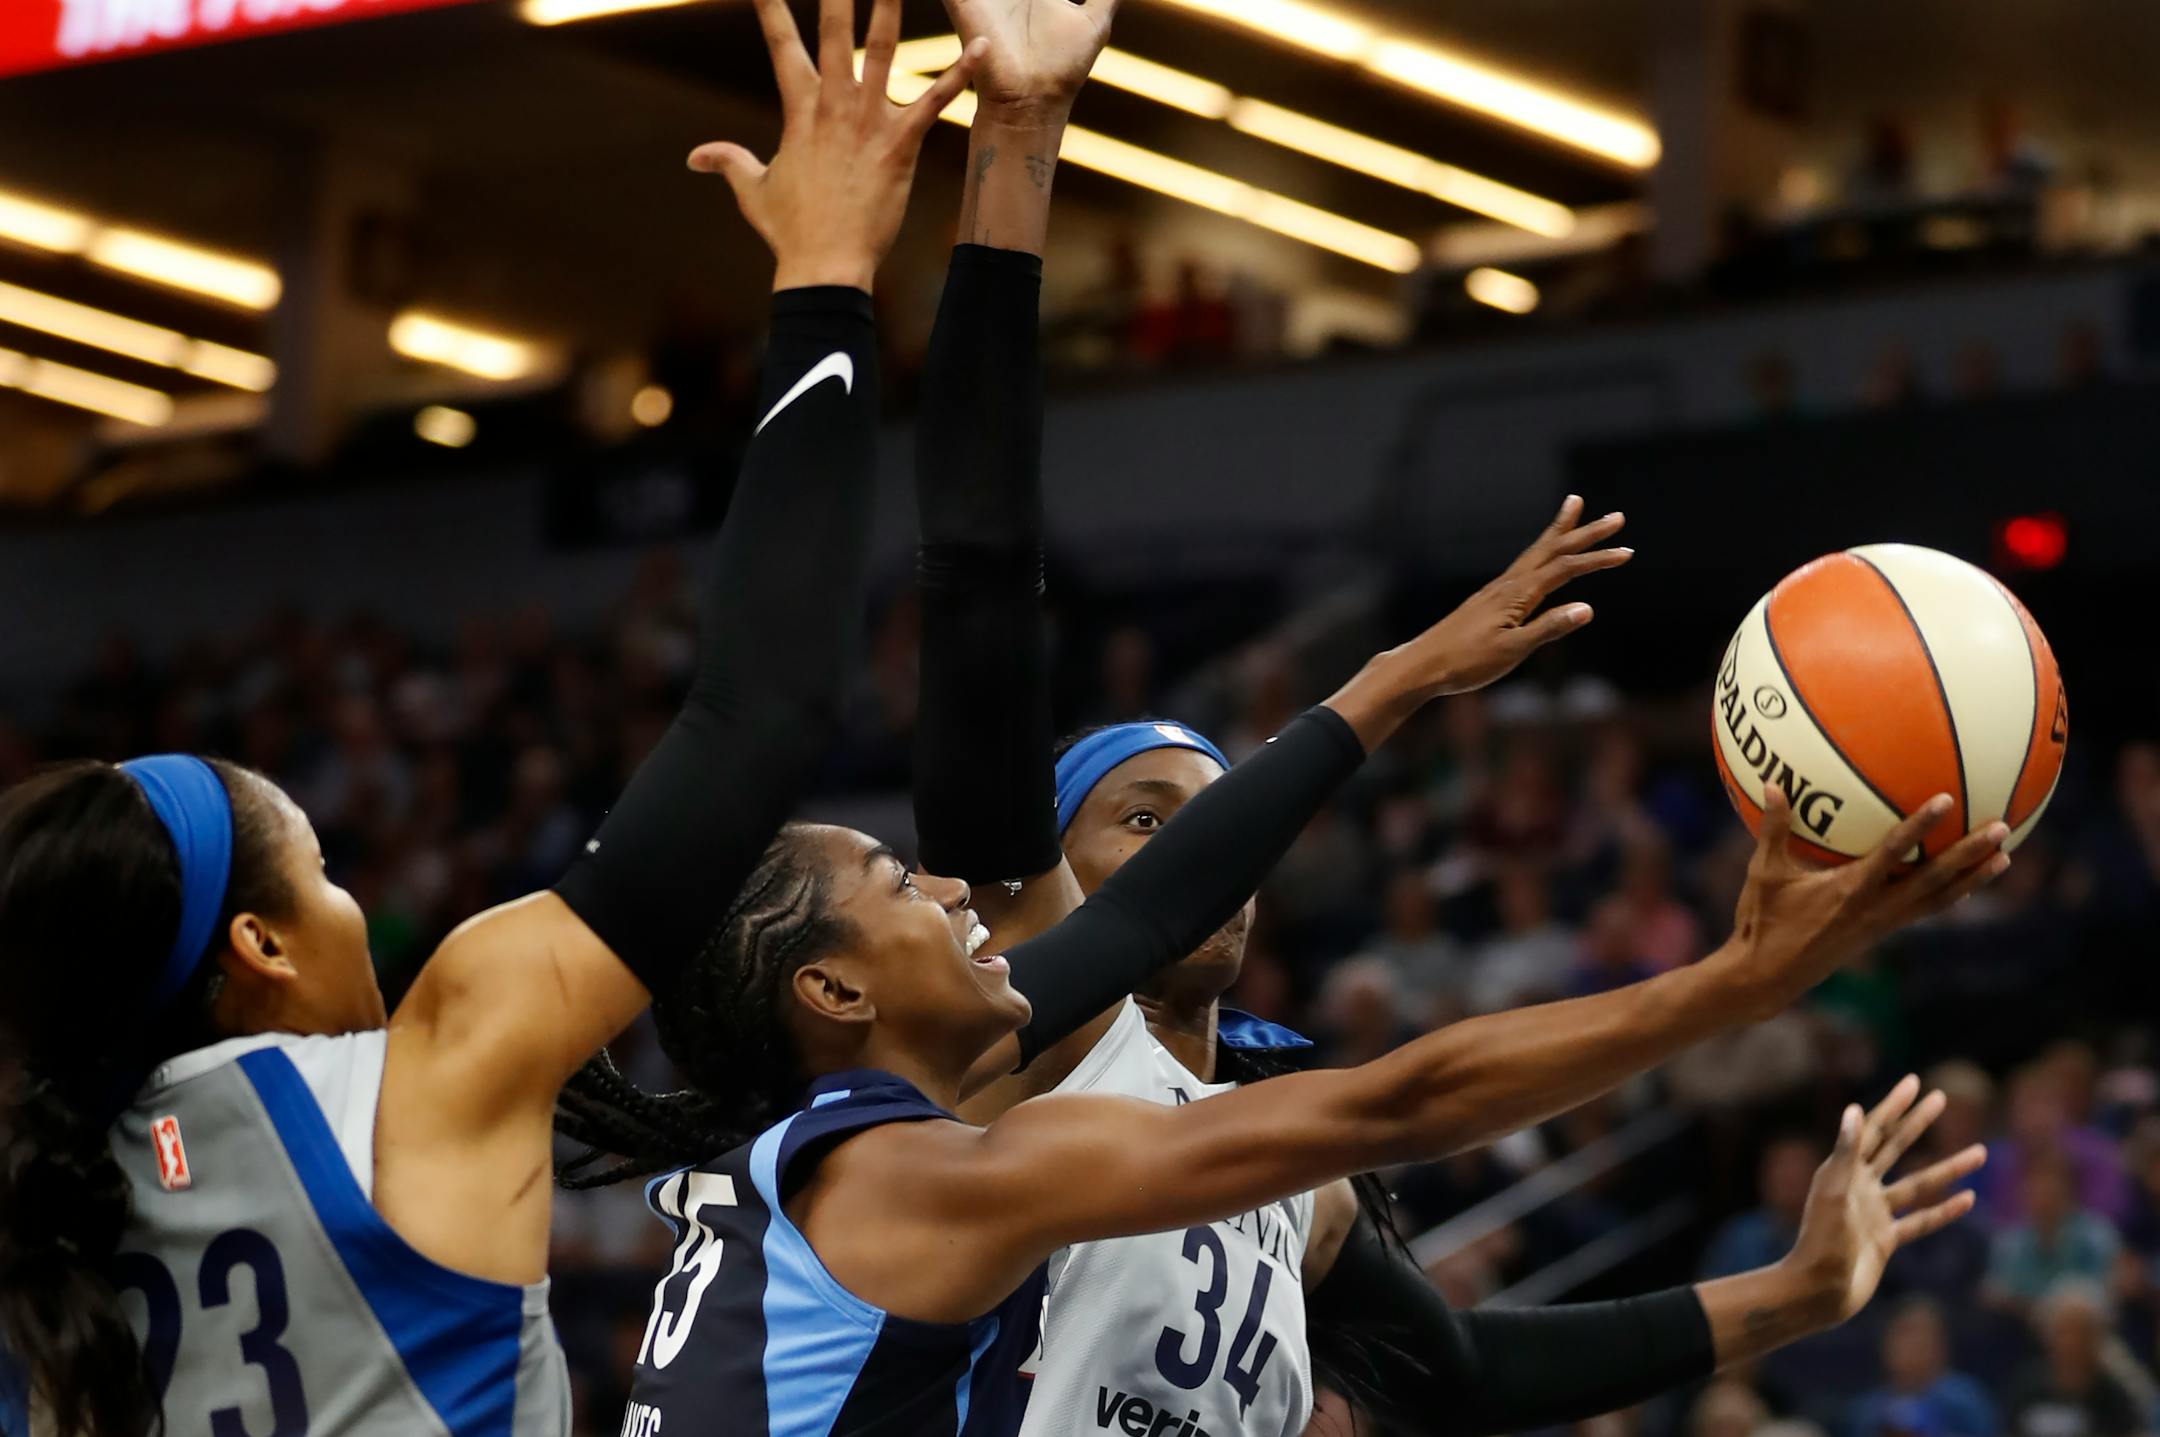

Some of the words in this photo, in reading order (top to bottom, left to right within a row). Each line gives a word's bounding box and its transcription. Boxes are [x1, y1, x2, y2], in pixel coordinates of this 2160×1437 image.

[1718, 632, 1844, 838] PALDING
[1096, 1385, 1212, 1437] veri
[1155, 1224, 1278, 1423] 34
